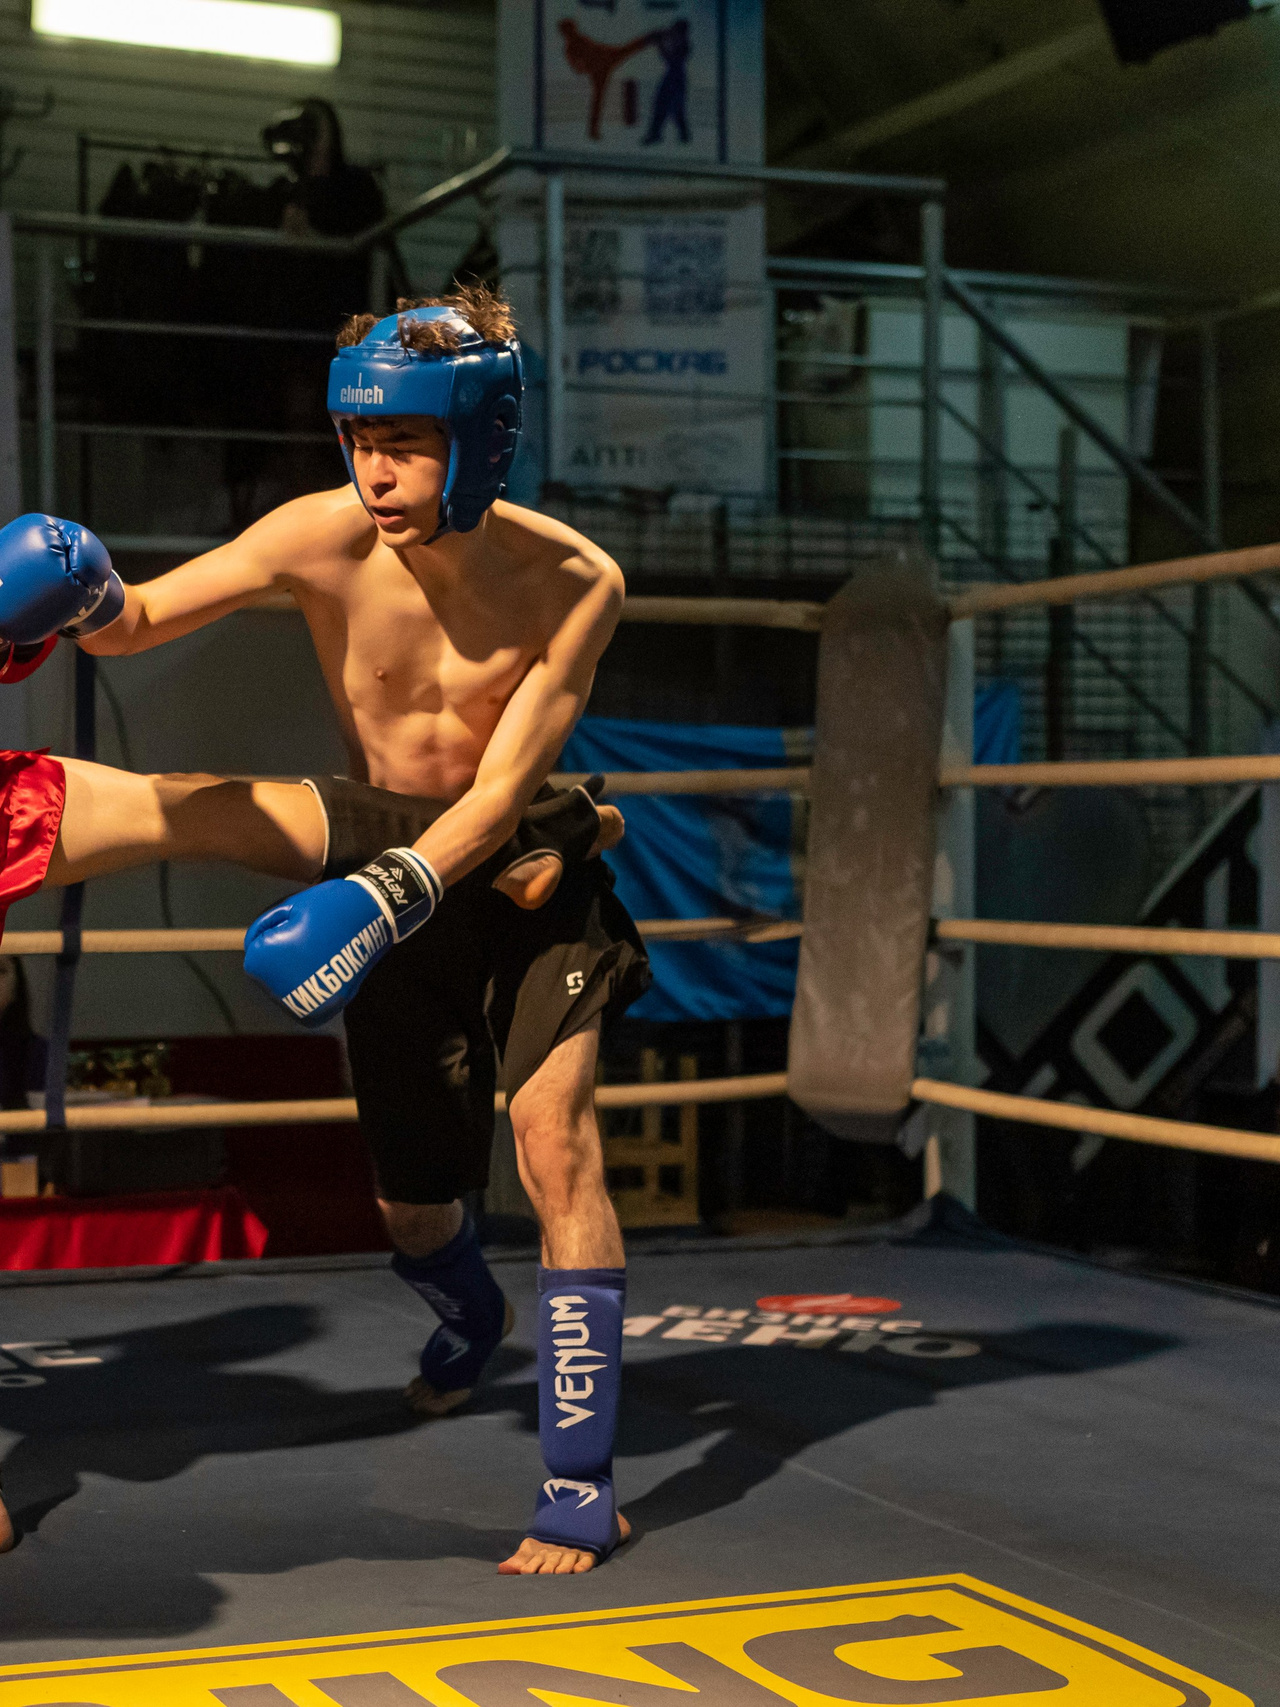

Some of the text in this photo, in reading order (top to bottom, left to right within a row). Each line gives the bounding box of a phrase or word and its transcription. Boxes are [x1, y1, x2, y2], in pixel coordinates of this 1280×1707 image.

[340, 381, 384, 406] clinch
[282, 914, 388, 1019] КИКБОКСИНГ
[548, 1295, 608, 1430] VENUM
